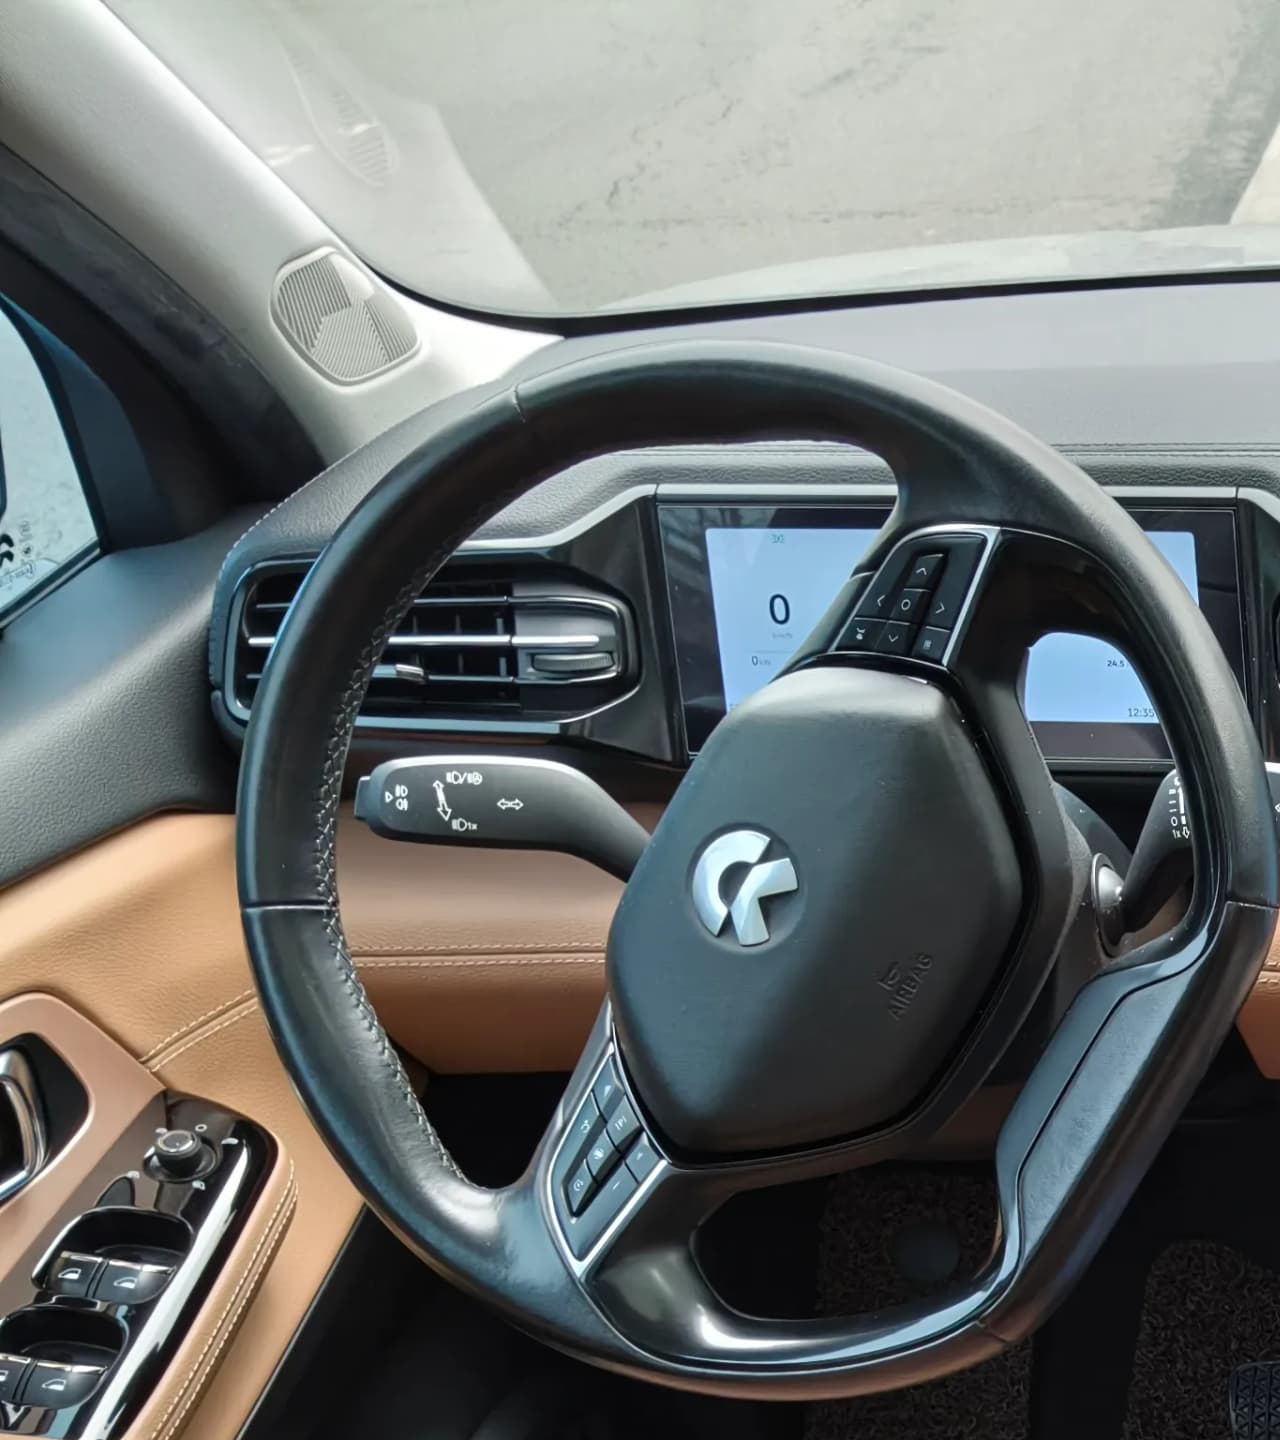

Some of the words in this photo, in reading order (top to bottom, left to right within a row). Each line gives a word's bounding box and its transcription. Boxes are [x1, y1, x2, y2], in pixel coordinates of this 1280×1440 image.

[769, 593, 791, 625] 0
[751, 655, 759, 666] 0
[1107, 660, 1125, 668] 24.5
[1127, 707, 1155, 718] 12:35
